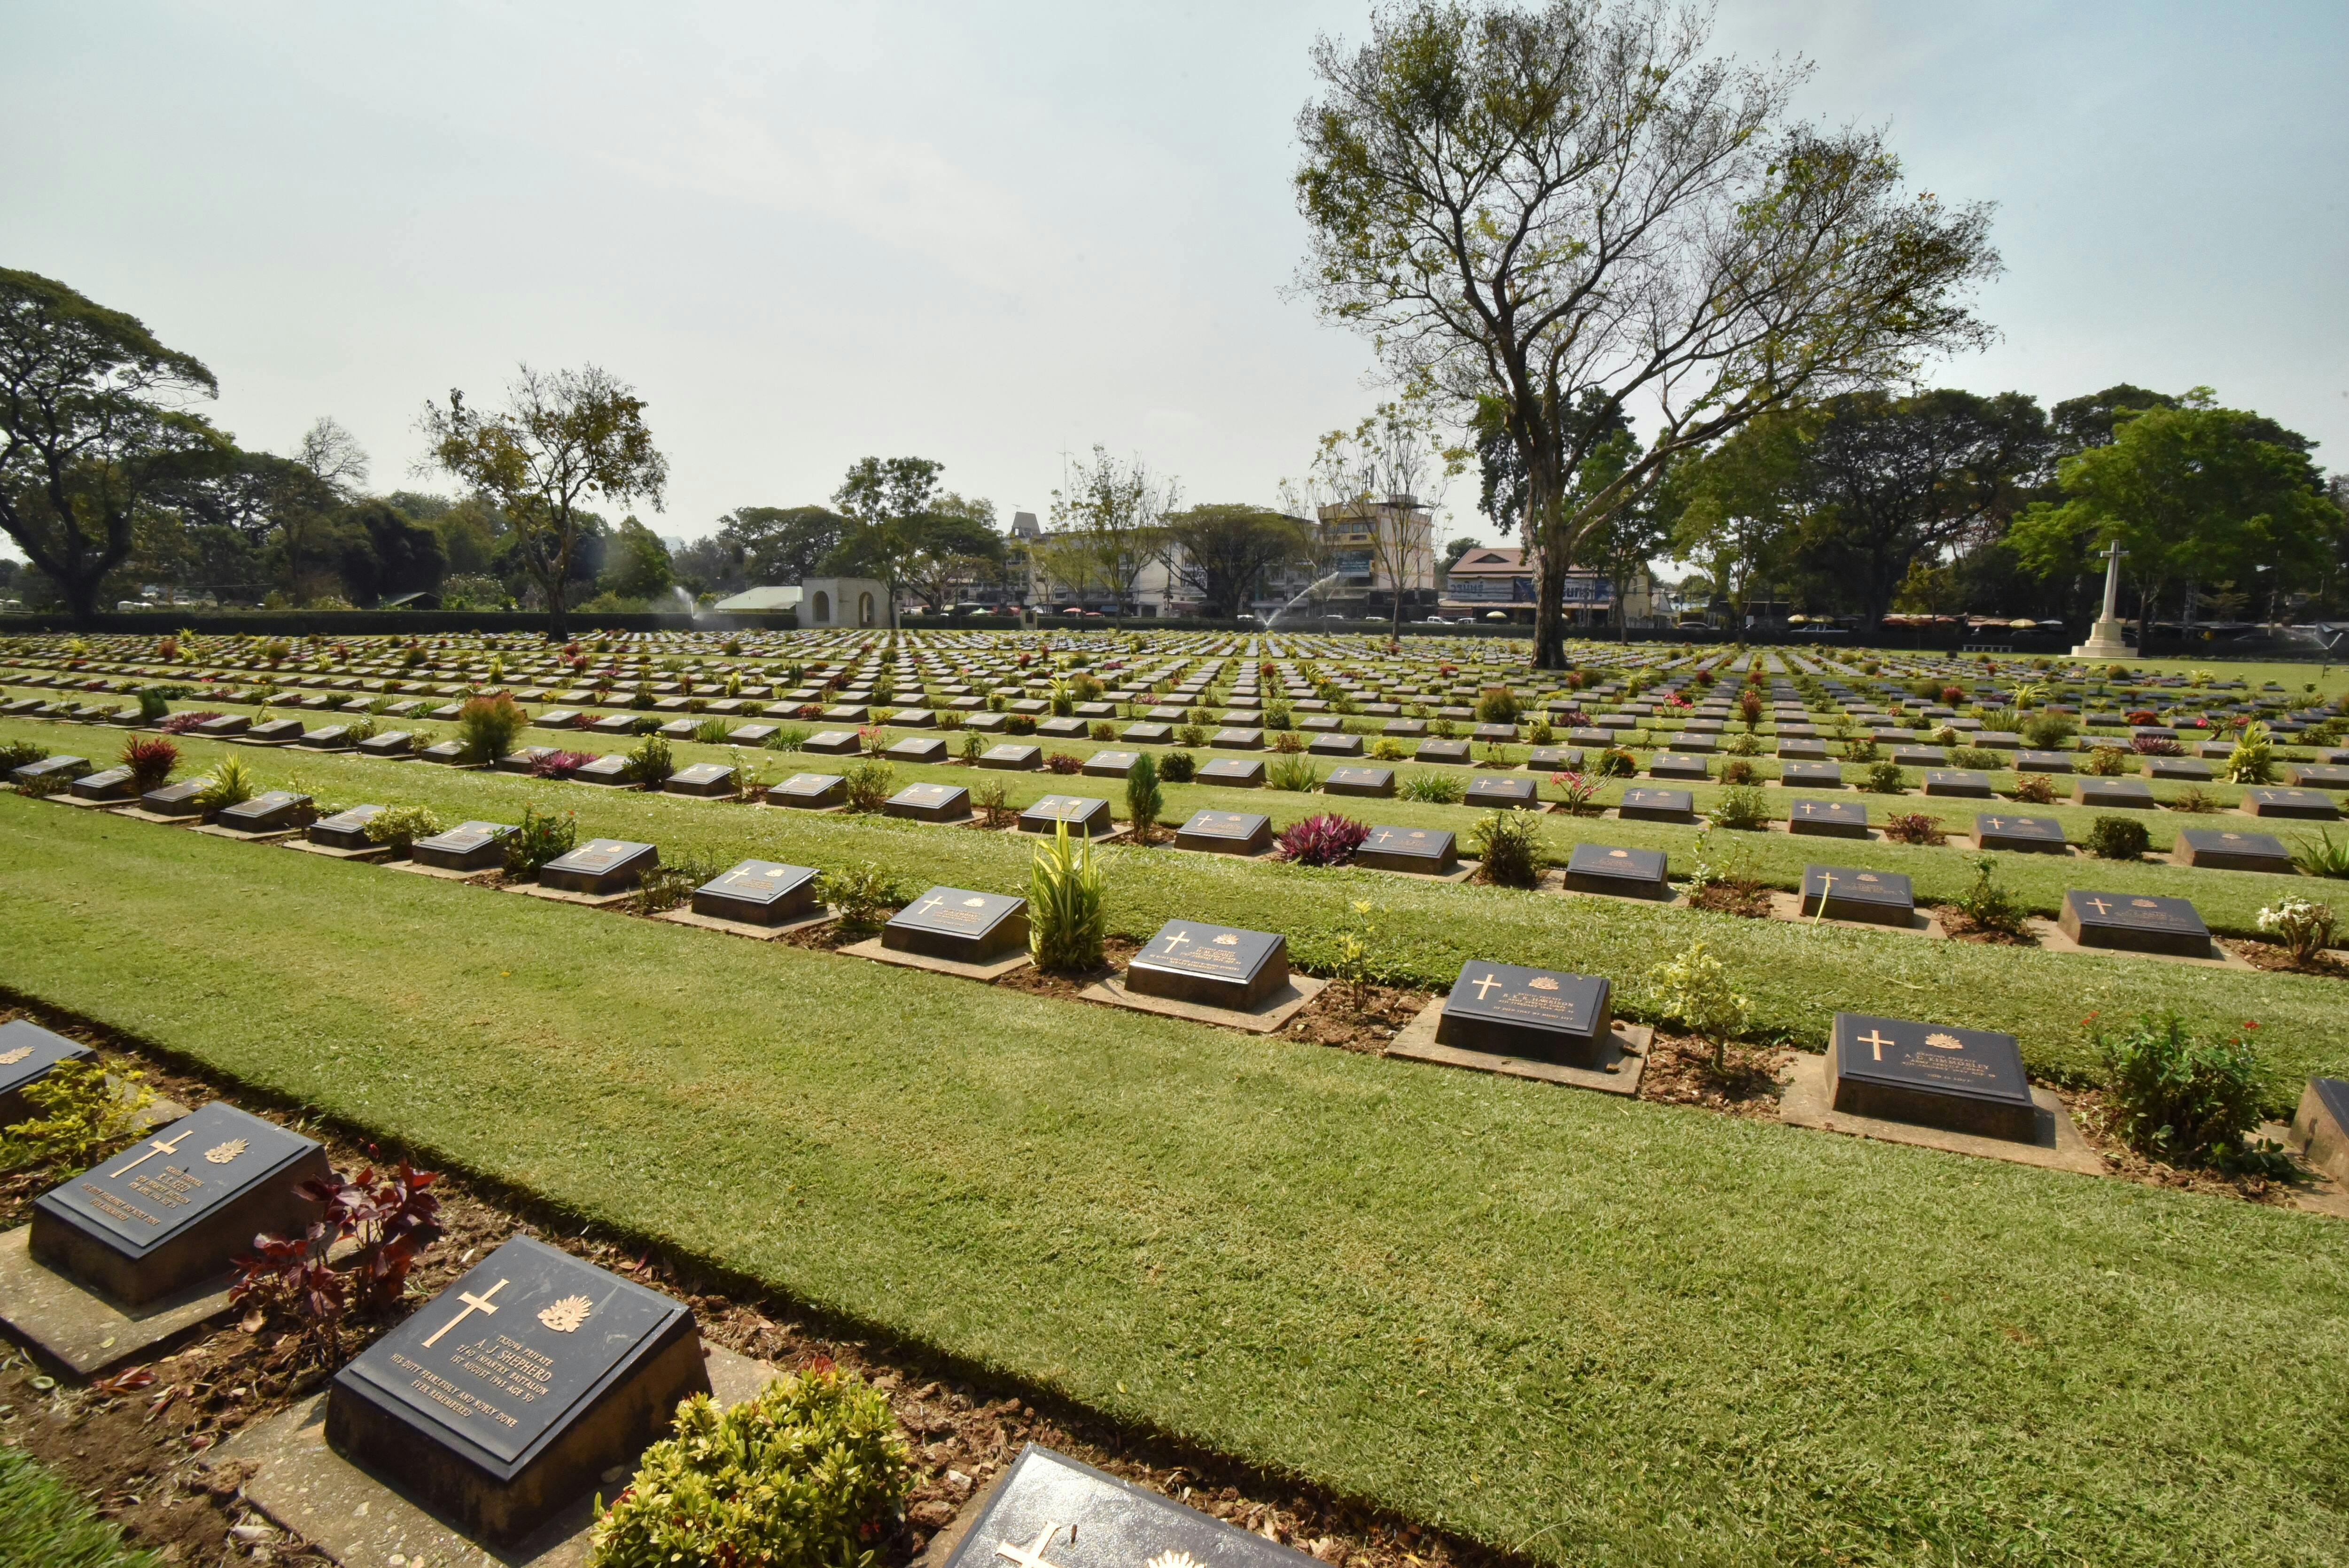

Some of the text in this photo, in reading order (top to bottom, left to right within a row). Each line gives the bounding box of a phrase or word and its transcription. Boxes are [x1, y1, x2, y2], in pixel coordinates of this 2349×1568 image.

[1532, 997, 1574, 1007] HARRISON
[1918, 1063, 1949, 1071] JANUARY
[138, 1186, 153, 1196] APRIL
[147, 1180, 168, 1193] INFANTRY
[165, 1190, 192, 1205] BATTALION
[169, 1180, 191, 1193] REED
[181, 1174, 205, 1188] CORPORAL
[90, 1186, 105, 1195] DUTY
[100, 1192, 126, 1207] FEARLESSLY
[124, 1203, 135, 1212] AND
[131, 1207, 149, 1219] NOBLY
[146, 1215, 161, 1226] DONE
[90, 1198, 129, 1221] EVER REMEMBERED
[474, 1338, 552, 1382] A. J. SHEPHERD
[497, 1335, 554, 1366] TX5094 PRIVATE
[450, 1354, 534, 1403] 1ST AUGUST 1943 AGE 30
[456, 1344, 549, 1396] 2/40 INFANTRY BATTALION
[390, 1353, 518, 1428] HIS DUTY FEARLESSLY AND NOBLY DONE
[411, 1379, 473, 1418] EVER REMEMBERED
